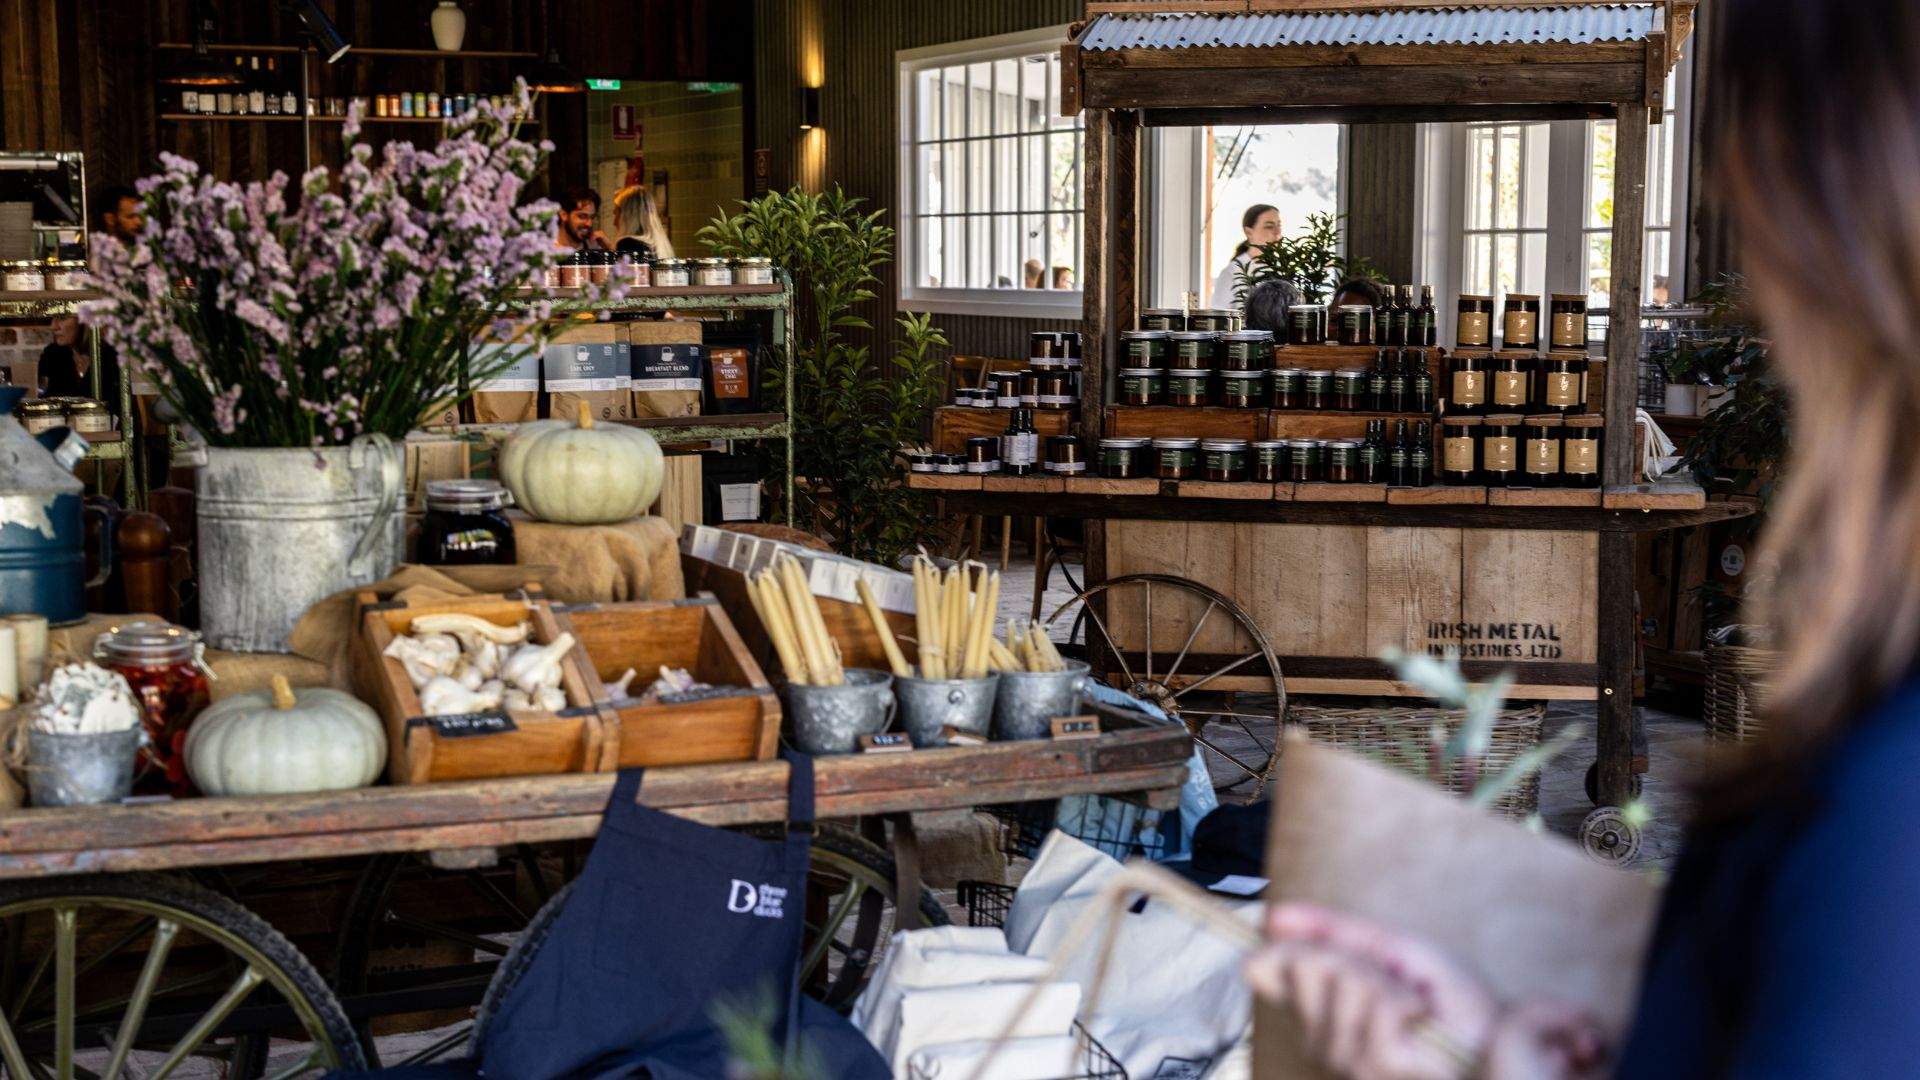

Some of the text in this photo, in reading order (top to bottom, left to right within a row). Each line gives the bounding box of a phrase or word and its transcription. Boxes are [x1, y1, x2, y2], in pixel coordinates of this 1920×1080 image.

[1428, 622, 1561, 641] IRISH METAL
[1531, 643, 1562, 659] LTD
